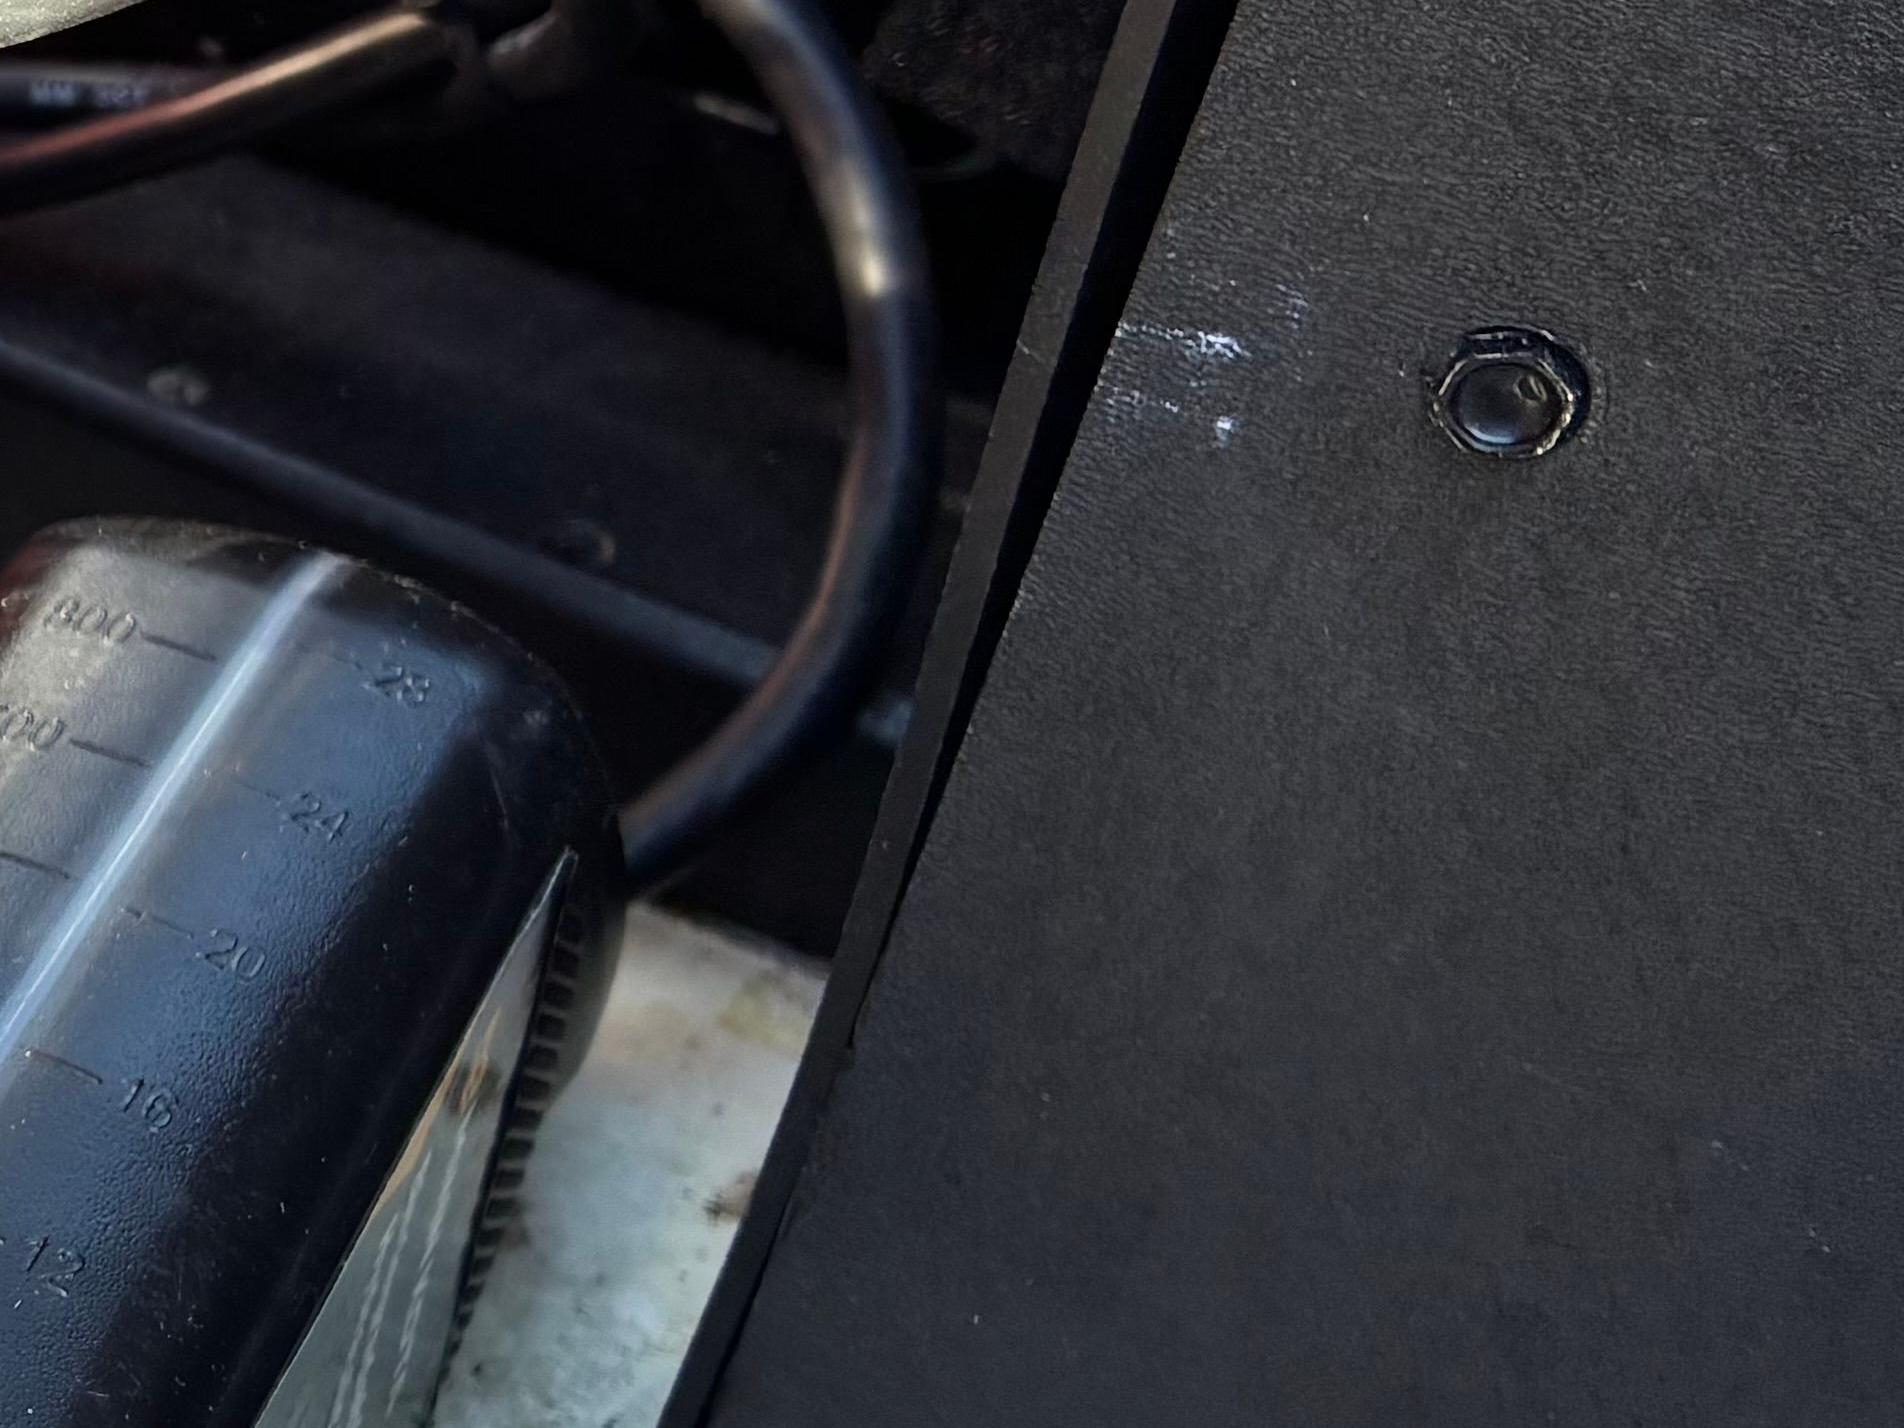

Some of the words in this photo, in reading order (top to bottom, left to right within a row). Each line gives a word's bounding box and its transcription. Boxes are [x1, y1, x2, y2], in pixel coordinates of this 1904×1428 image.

[196, 925, 268, 983] 20
[121, 1077, 181, 1134] 16
[23, 1234, 88, 1299] 12
